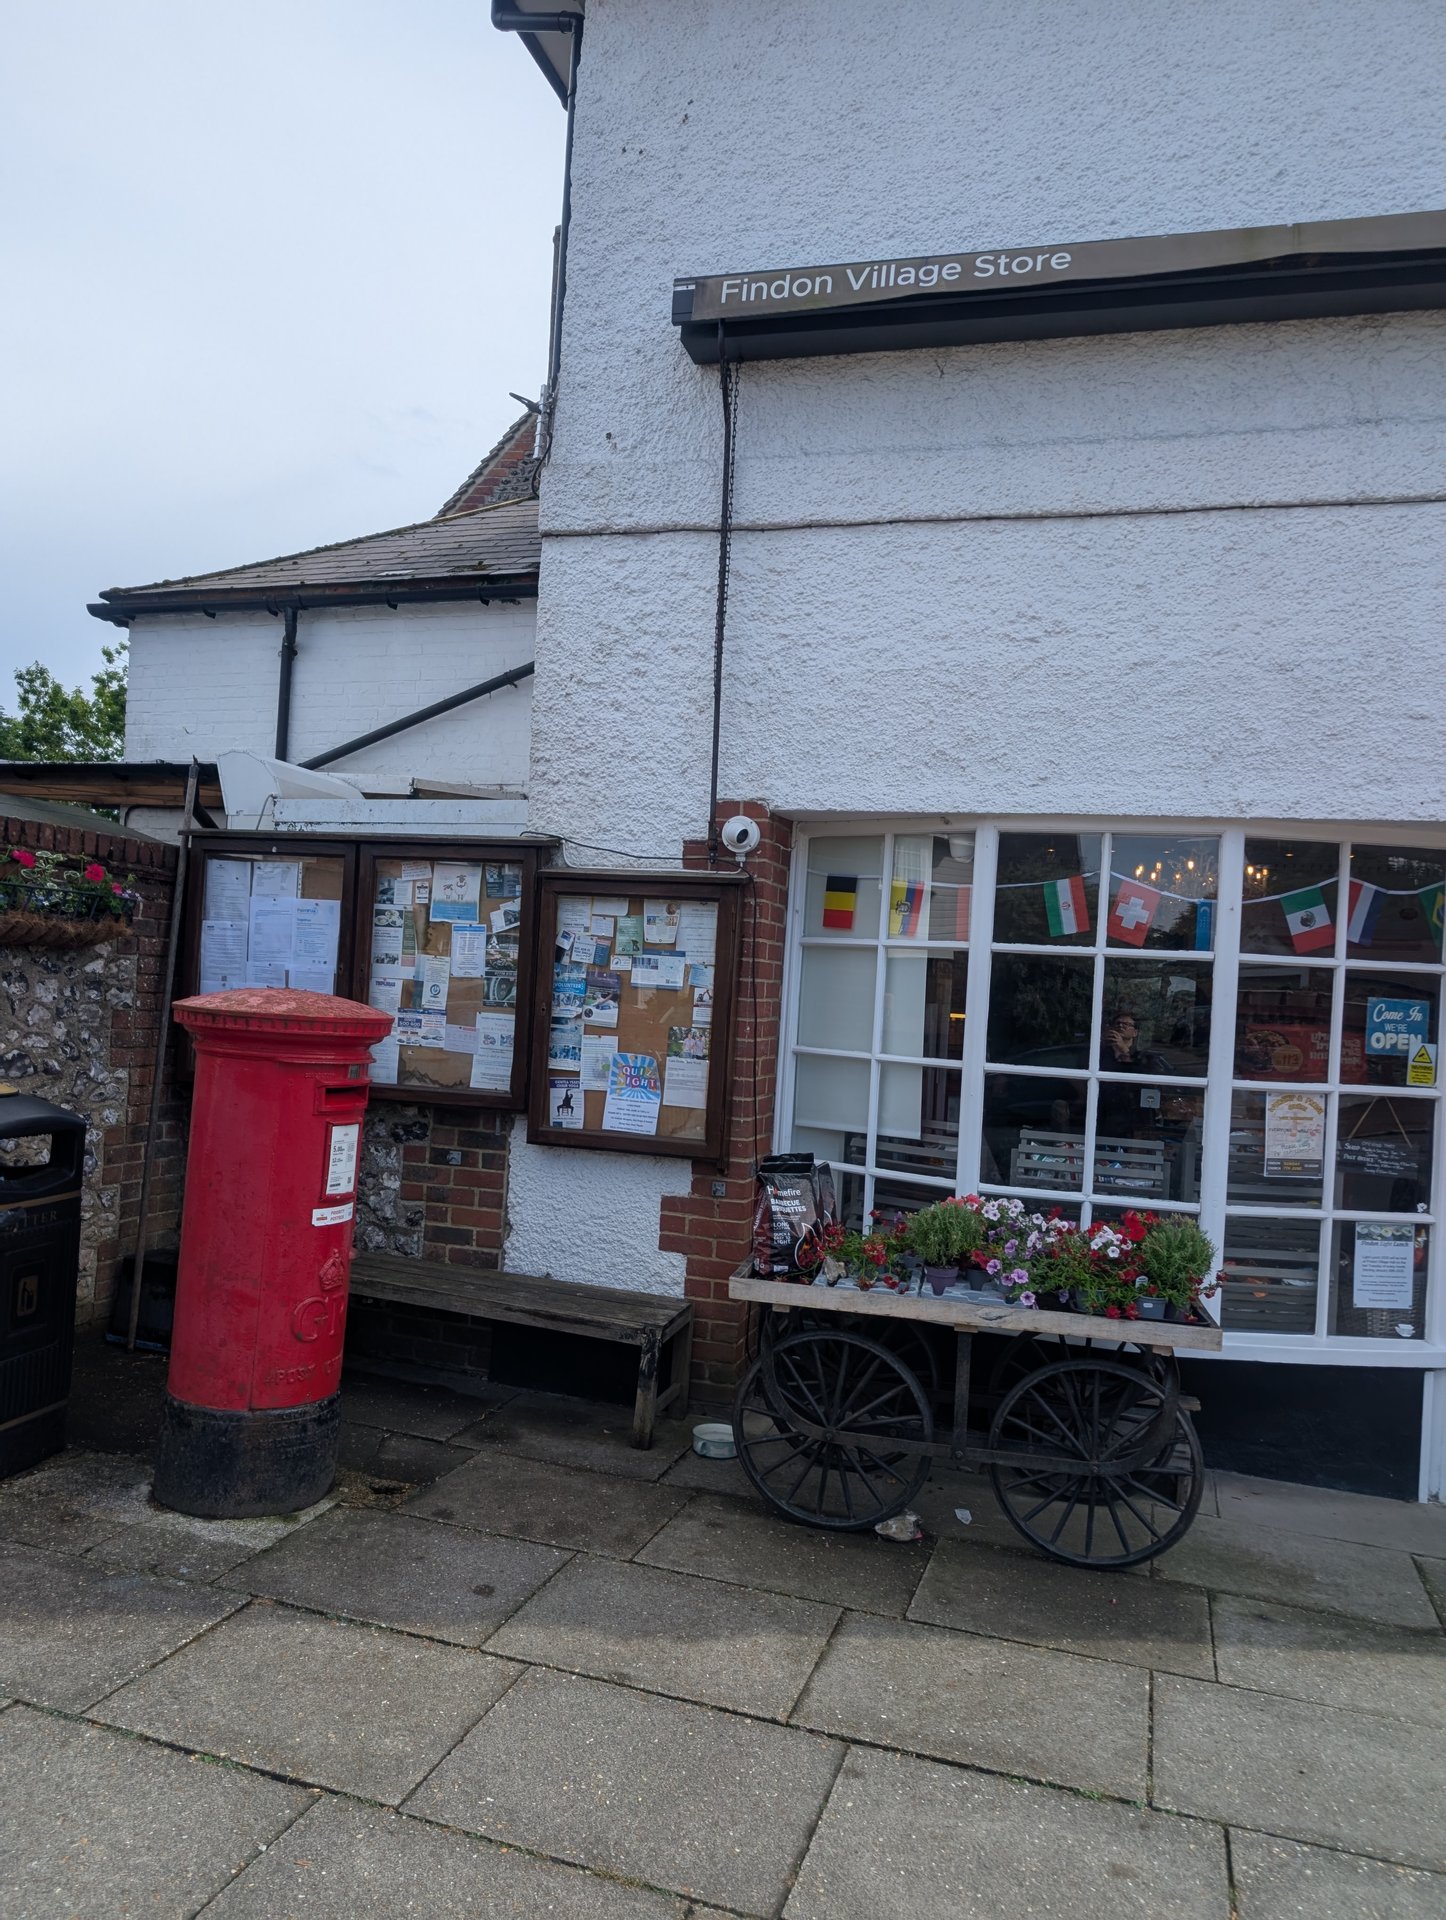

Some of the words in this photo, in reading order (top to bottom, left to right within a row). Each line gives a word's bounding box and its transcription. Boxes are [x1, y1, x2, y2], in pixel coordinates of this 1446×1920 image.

[720, 274, 832, 304] Findon
[846, 262, 962, 291] Village
[973, 252, 1072, 278] Store
[1373, 1003, 1404, 1022] Come
[1406, 1006, 1423, 1021] In
[1384, 1023, 1408, 1032] WE'RE
[1370, 1032, 1422, 1050] OPEN
[770, 1198, 801, 1207] BARBECUE
[771, 1205, 807, 1213] BRIQUETTES
